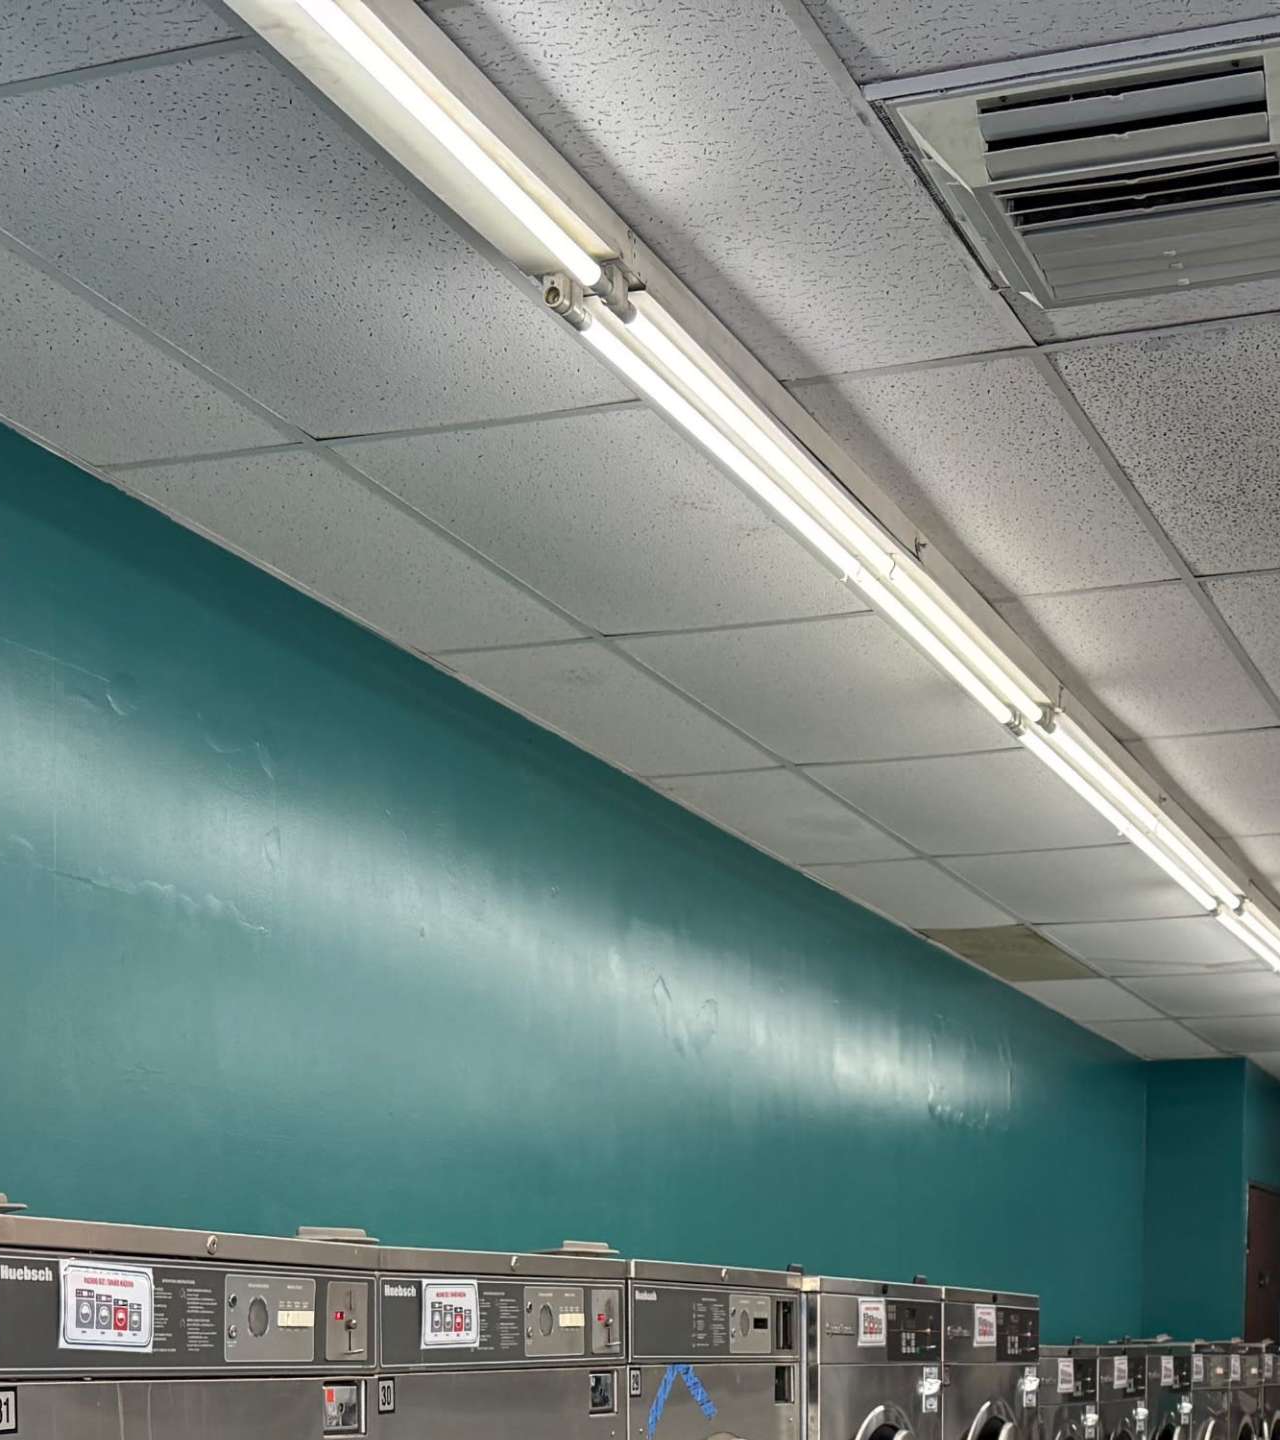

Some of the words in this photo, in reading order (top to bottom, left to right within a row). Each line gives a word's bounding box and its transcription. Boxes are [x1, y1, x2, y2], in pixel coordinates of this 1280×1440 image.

[0, 1264, 53, 1282] Huebsch
[384, 1284, 417, 1298] Huebsch
[381, 1385, 392, 1406] 30
